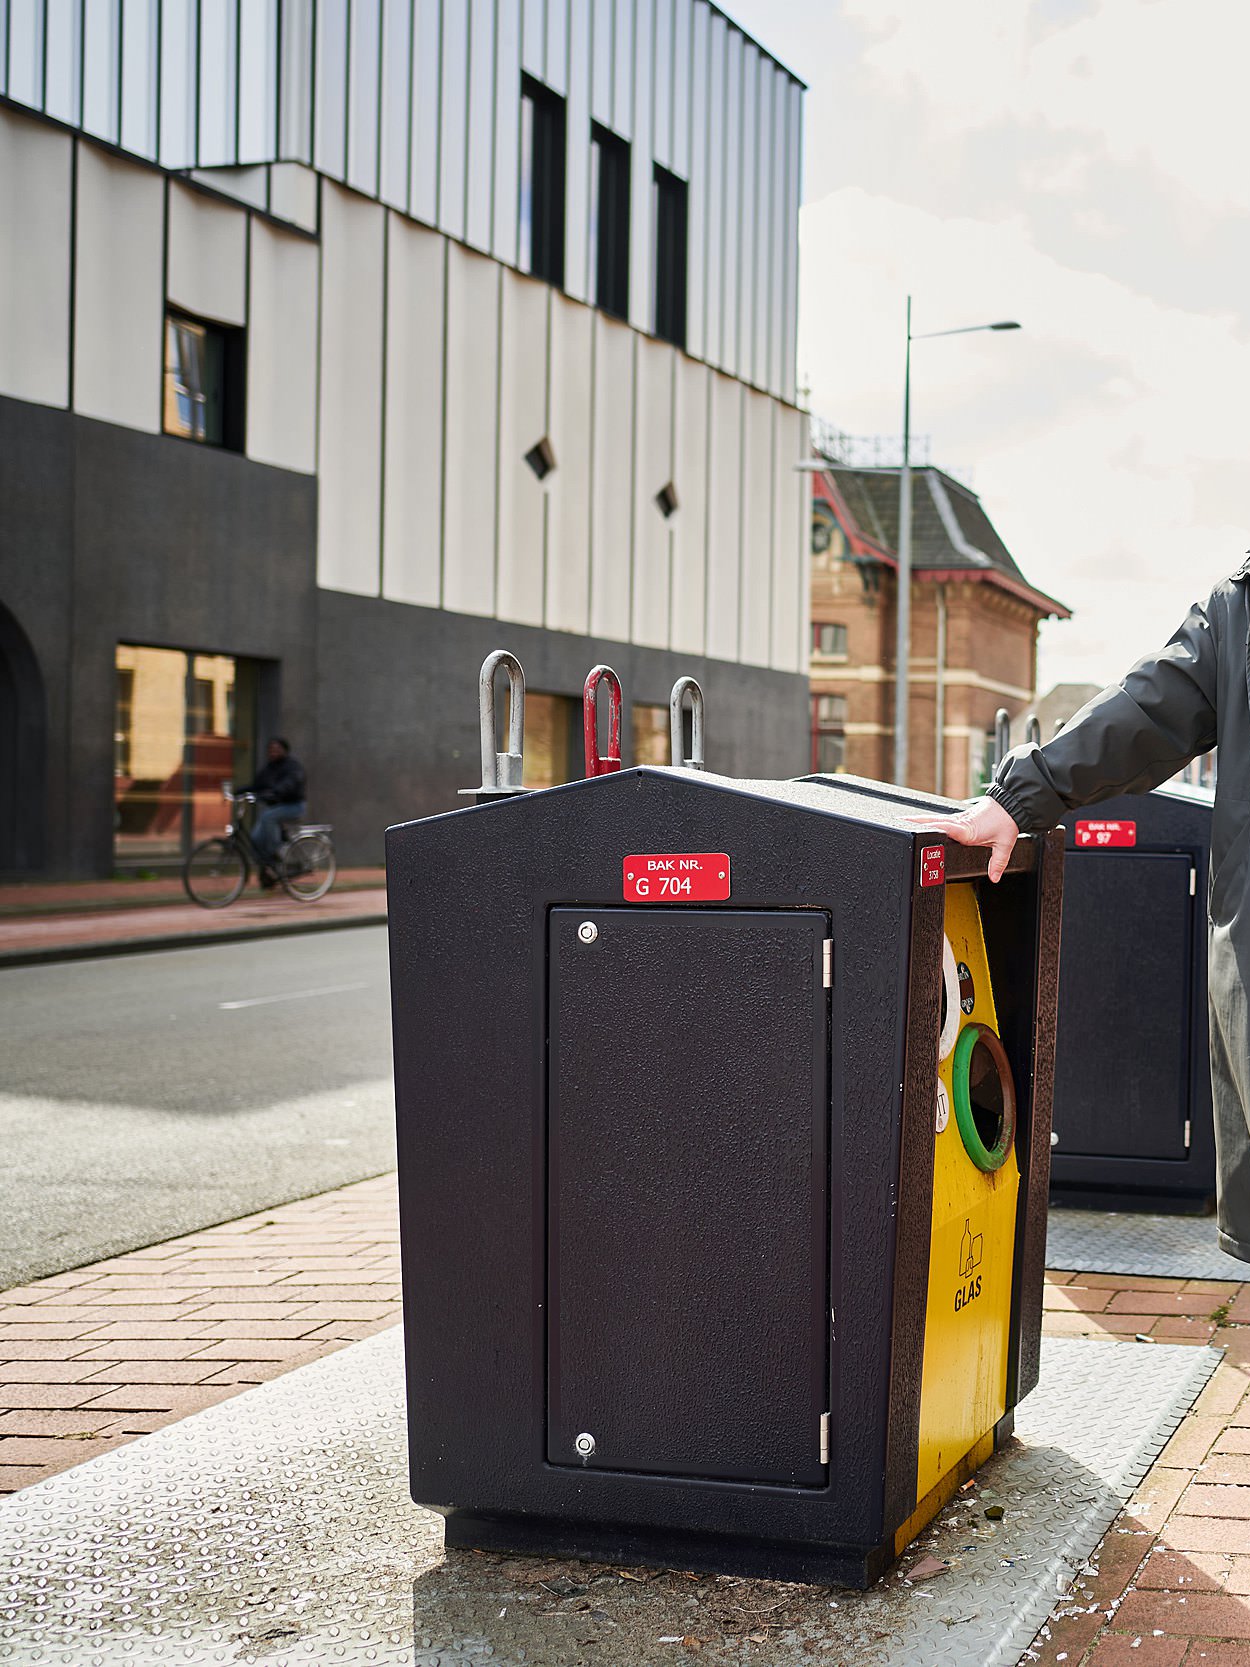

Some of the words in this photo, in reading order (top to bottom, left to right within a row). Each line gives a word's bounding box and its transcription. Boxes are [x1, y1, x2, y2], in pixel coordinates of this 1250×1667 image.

[1081, 831, 1091, 844] P
[1096, 831, 1111, 844] 97
[647, 860, 675, 871] BAK
[679, 860, 703, 870] NR.
[635, 877, 649, 896] G
[659, 877, 692, 895] 704
[954, 1275, 982, 1312] GLAS
